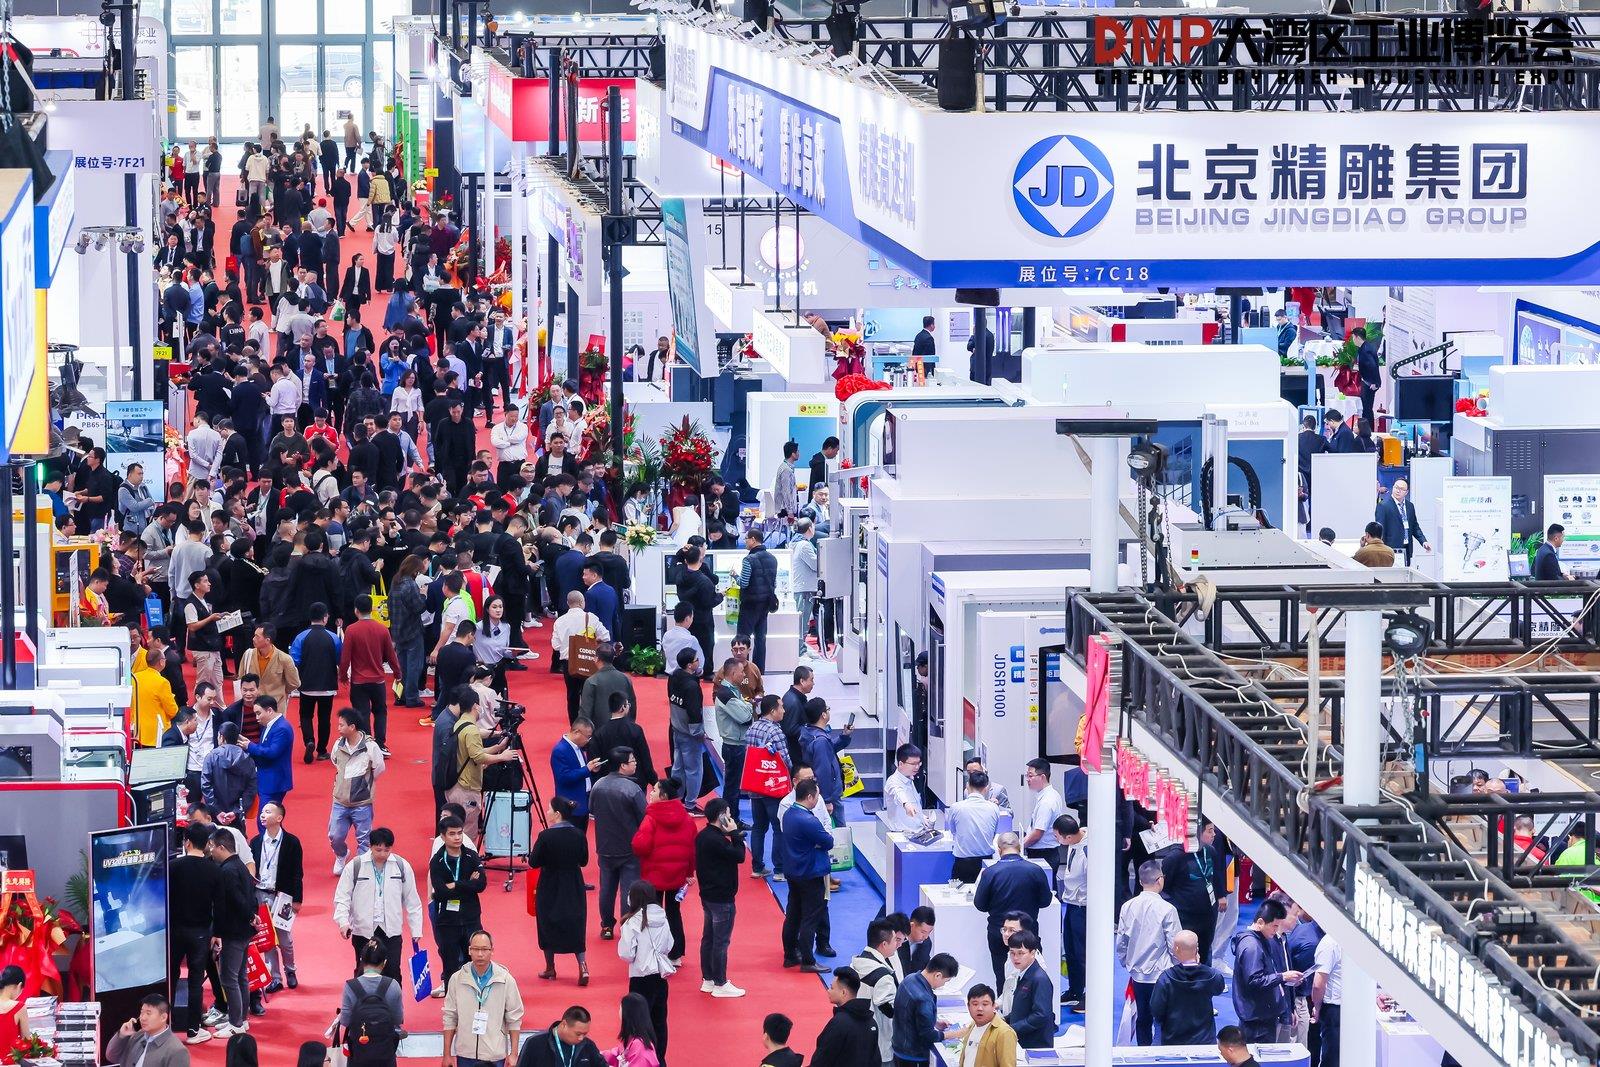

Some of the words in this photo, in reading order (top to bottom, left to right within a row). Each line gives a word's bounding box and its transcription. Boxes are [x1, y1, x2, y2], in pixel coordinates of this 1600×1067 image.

[75, 156, 145, 169] 展位号:7F21
[1137, 143, 1528, 200] 北京精雕集团
[1028, 165, 1099, 208] JD
[1136, 208, 1250, 226] BEIJING
[1264, 208, 1406, 226] JINGDIAO
[1426, 208, 1527, 226] GROUP
[1019, 265, 1150, 283] 展位号:7C18
[994, 653, 1006, 718] JDSR1000
